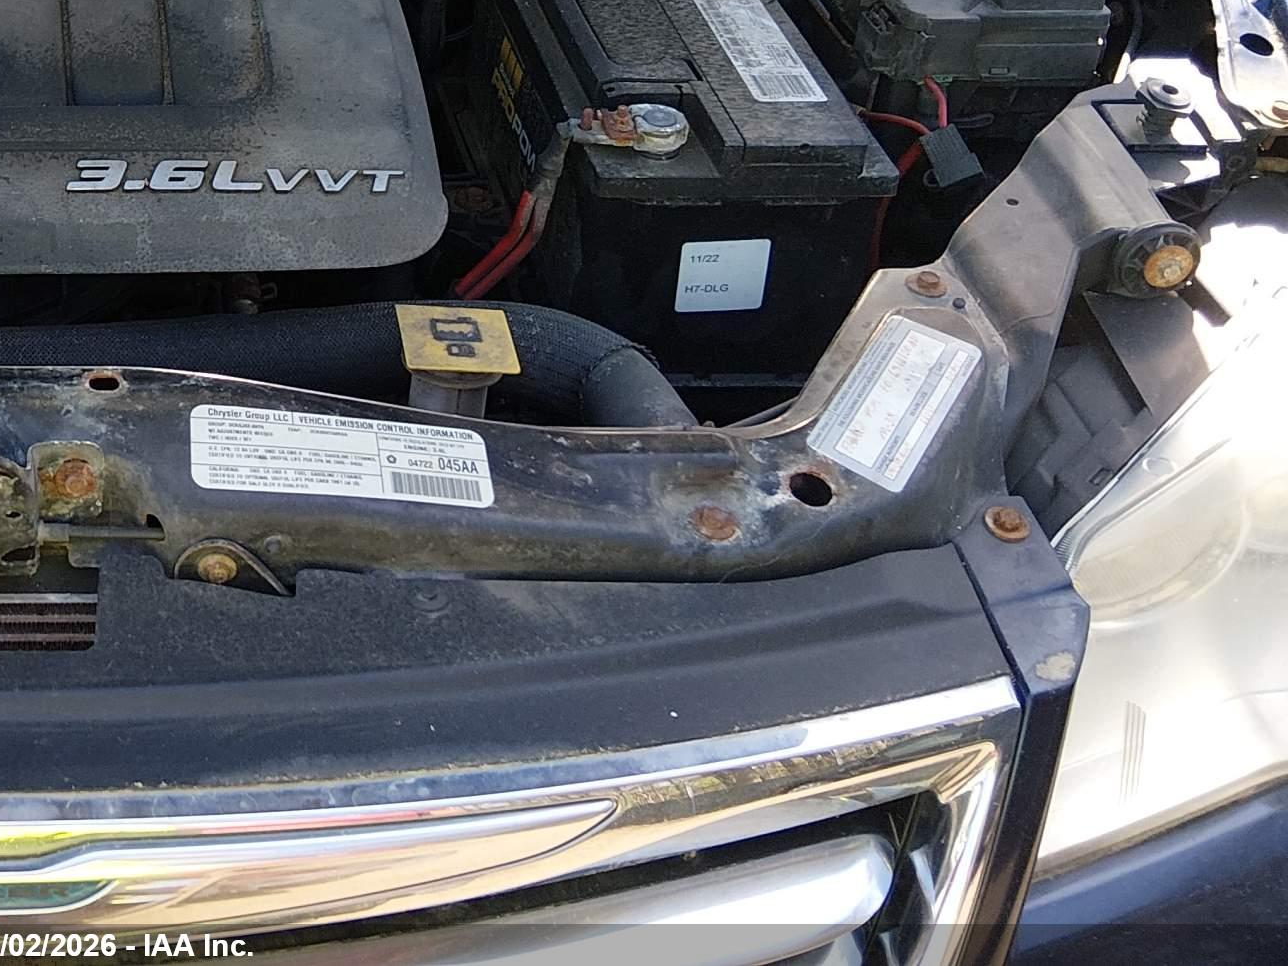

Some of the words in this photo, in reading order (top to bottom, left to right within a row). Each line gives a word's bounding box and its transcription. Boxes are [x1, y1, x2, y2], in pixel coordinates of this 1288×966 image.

[690, 254, 719, 263] 11/22
[684, 283, 728, 293] H7-DLG
[208, 408, 242, 418] Chrysler
[245, 411, 270, 421] Group
[273, 413, 288, 422] LLC
[299, 416, 331, 426] VEHICLE
[335, 419, 374, 430] EMISSION
[376, 423, 414, 434] CONTROL
[416, 427, 473, 440] INFORMATION
[408, 458, 433, 469] 04722
[438, 457, 479, 474] 045AA
